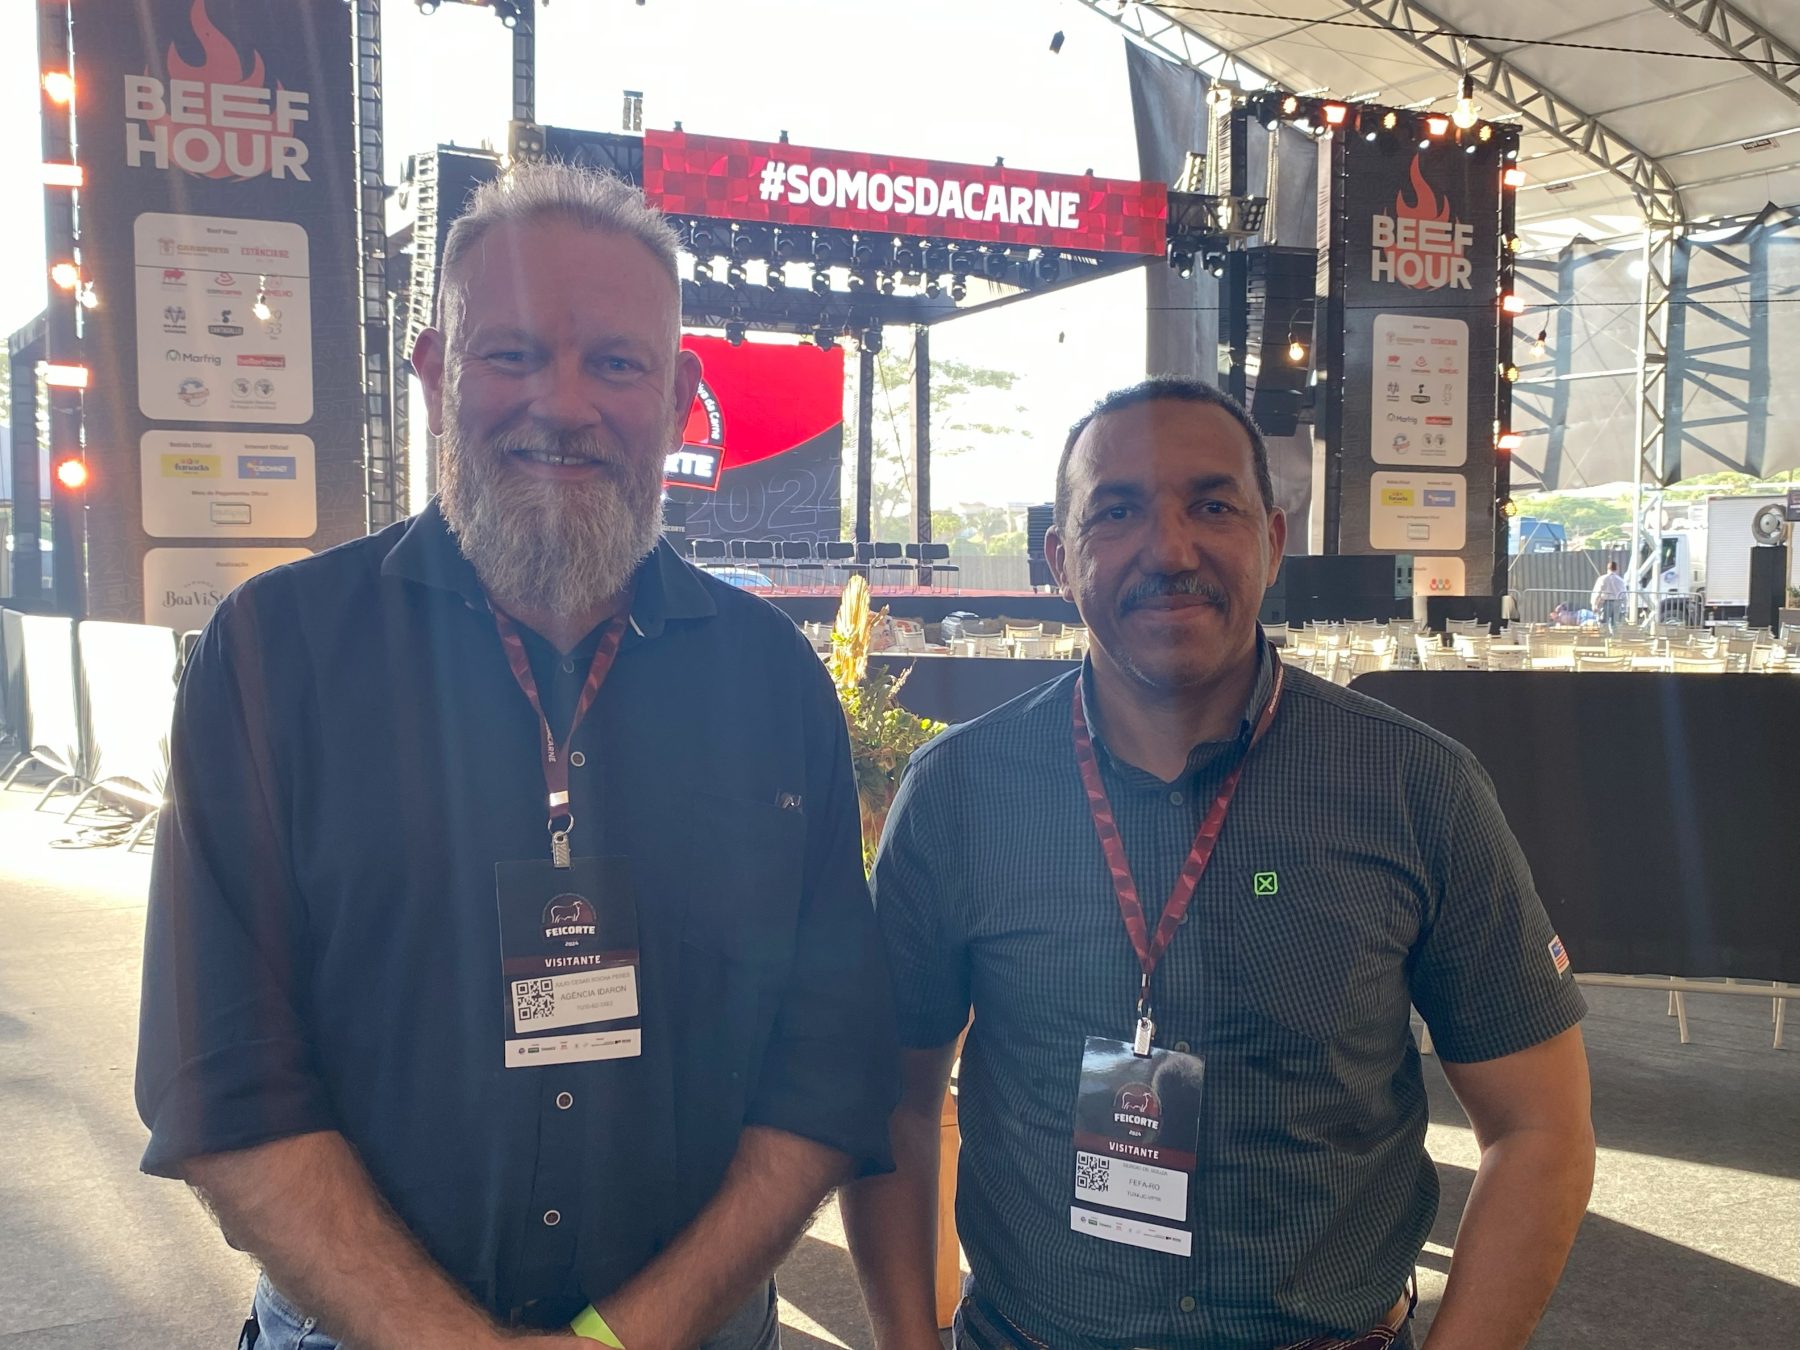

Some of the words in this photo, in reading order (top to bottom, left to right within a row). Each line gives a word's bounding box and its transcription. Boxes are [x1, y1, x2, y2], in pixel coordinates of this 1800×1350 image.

[124, 74, 310, 133] BEEF
[125, 122, 312, 182] HOUR
[759, 161, 1081, 229] #SOMOSDACARNE
[1372, 214, 1474, 256] BEEF
[1371, 249, 1473, 290] HOUR
[183, 353, 222, 366] Marfrig
[709, 411, 721, 440] Carne
[663, 451, 714, 477] RTE
[545, 925, 596, 938] FEICORTE
[545, 955, 601, 968] VISITANTE
[1114, 1113, 1159, 1130] FEICORTE
[1109, 1141, 1159, 1159] VISITANTE
